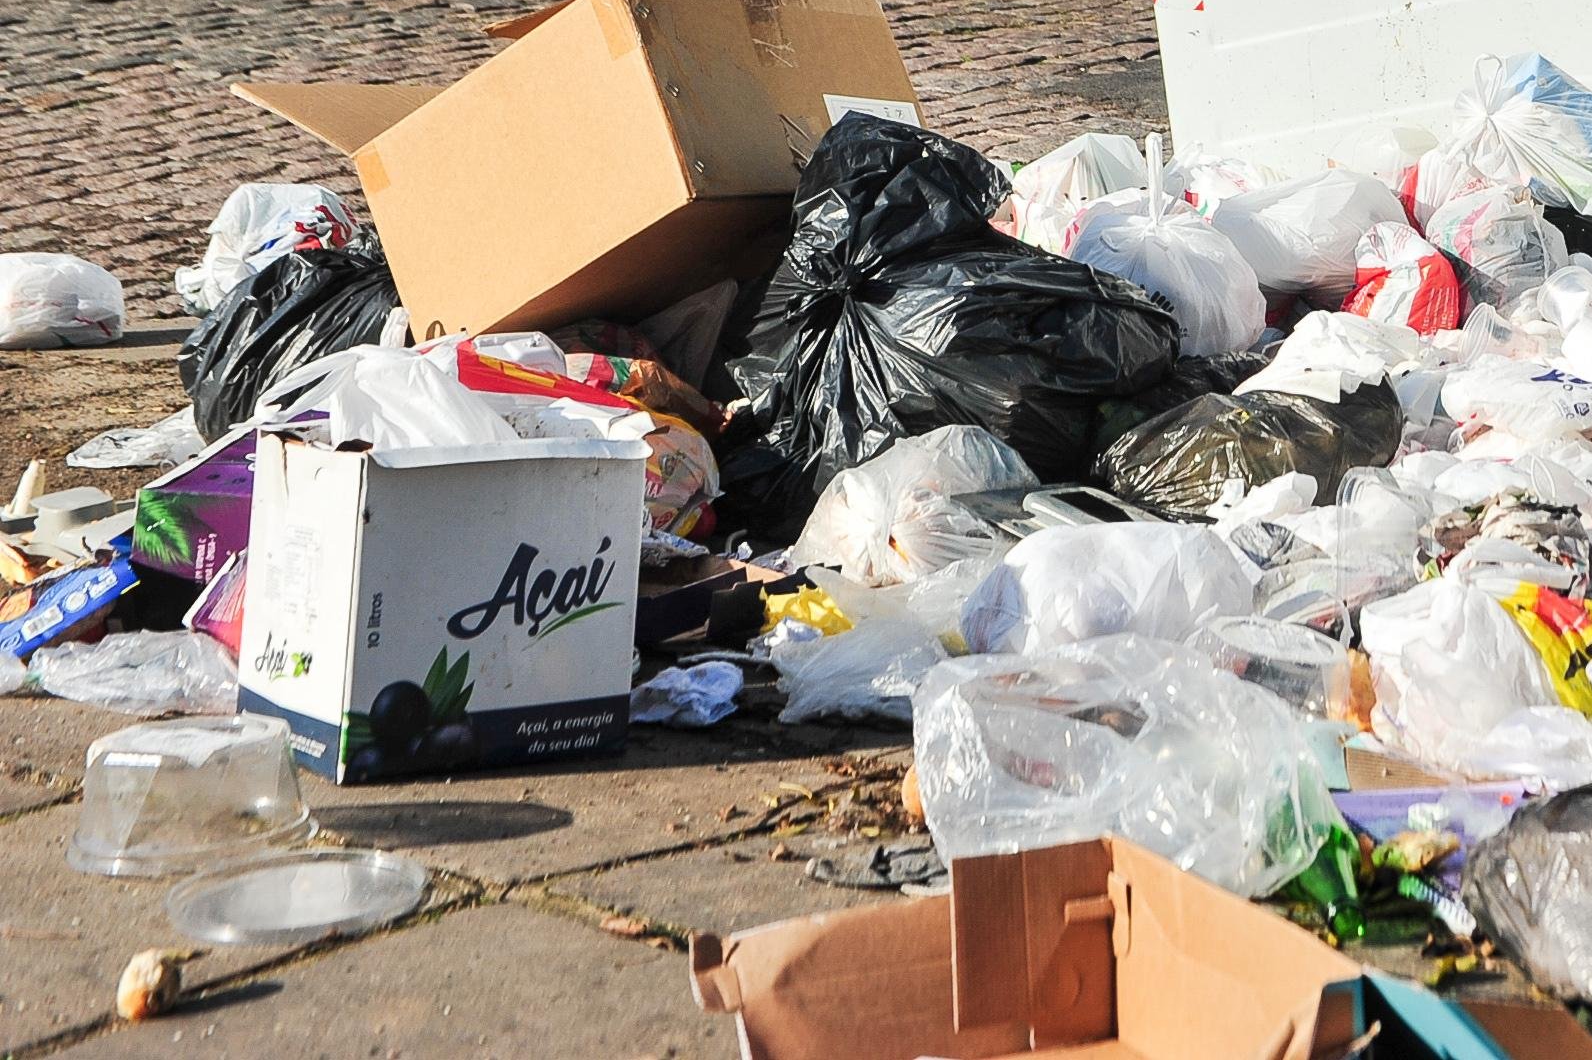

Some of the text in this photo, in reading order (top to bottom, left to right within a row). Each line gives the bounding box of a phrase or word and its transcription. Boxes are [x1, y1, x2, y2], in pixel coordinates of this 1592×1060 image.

[447, 536, 616, 640] Açaí
[366, 592, 383, 649] 10 litros
[516, 711, 614, 736] Açaí, a energia
[528, 733, 601, 754] do seu dia!
